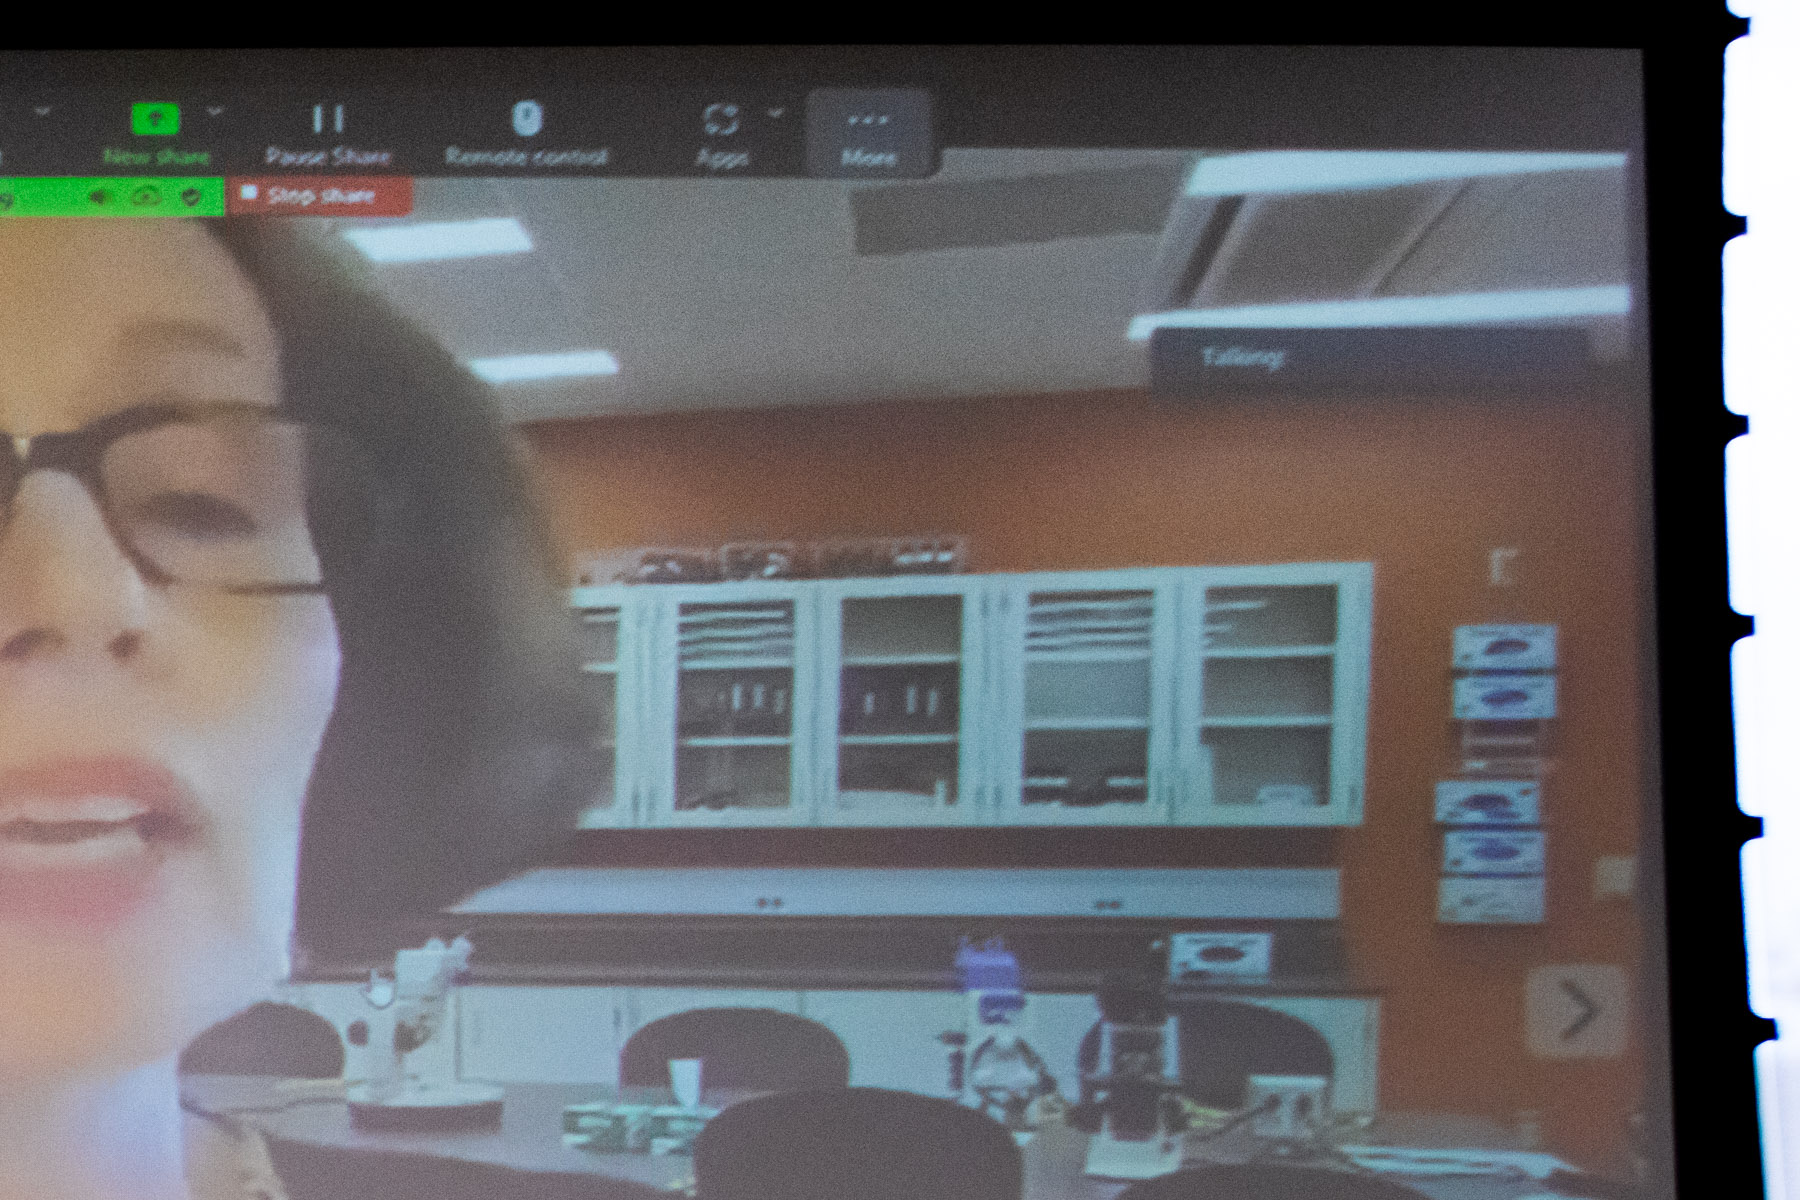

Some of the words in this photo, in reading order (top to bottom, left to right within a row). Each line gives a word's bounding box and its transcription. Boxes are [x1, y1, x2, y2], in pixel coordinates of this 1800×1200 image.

[103, 147, 151, 166] New
[156, 147, 211, 166] share
[265, 146, 327, 166] Pause
[332, 146, 392, 166] Share
[444, 146, 528, 166] Remote
[532, 146, 609, 166] control
[841, 147, 898, 167] More
[267, 186, 316, 206] Stop
[320, 186, 376, 205] share
